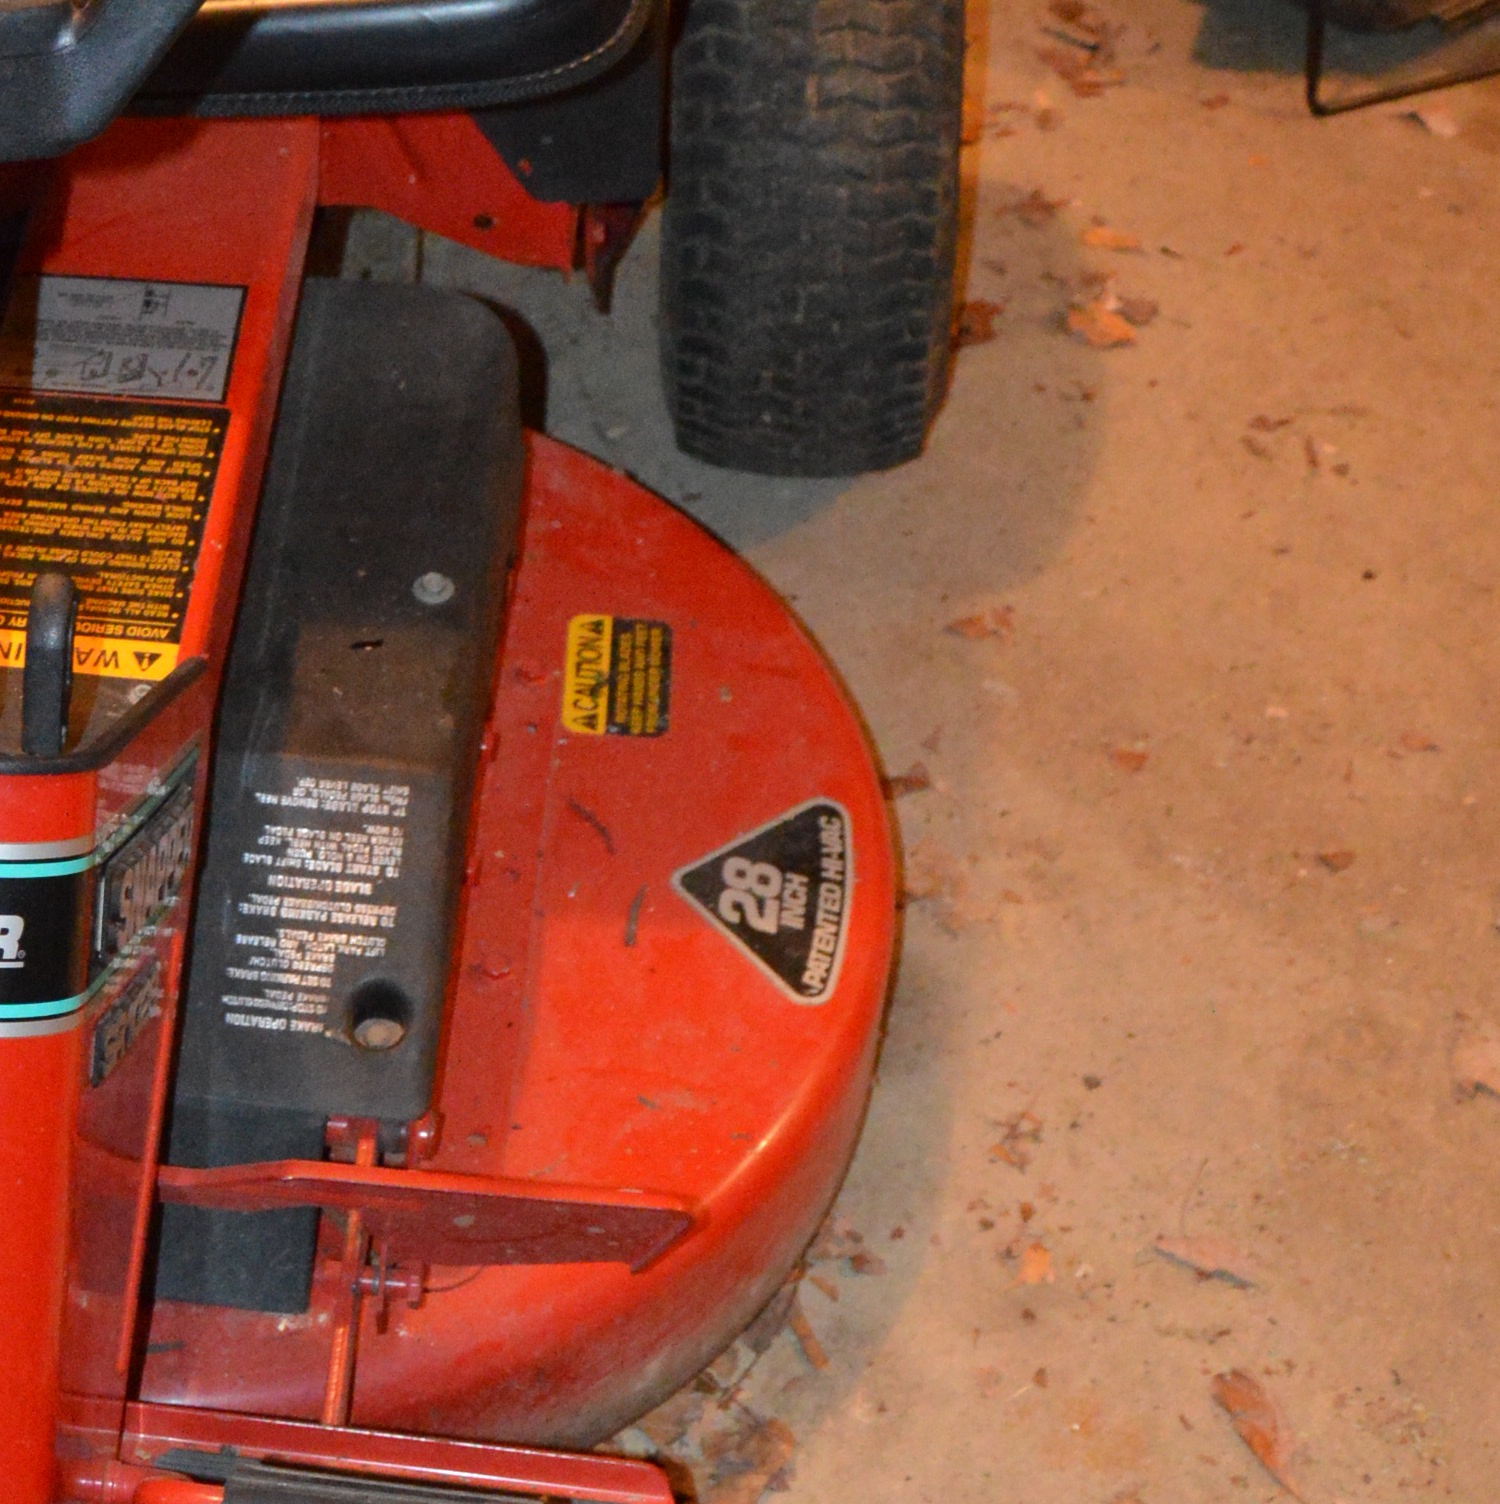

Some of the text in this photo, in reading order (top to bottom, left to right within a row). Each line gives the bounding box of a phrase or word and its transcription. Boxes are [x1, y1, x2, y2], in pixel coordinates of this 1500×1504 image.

[126, 626, 170, 638] AVOID
[345, 863, 380, 877] START
[268, 875, 372, 896] BLADE OPERATION
[718, 856, 783, 934] 28
[780, 872, 809, 930] INCH
[802, 815, 844, 989] PATENTED HI-VAC
[225, 1012, 287, 1031] OPERATION
